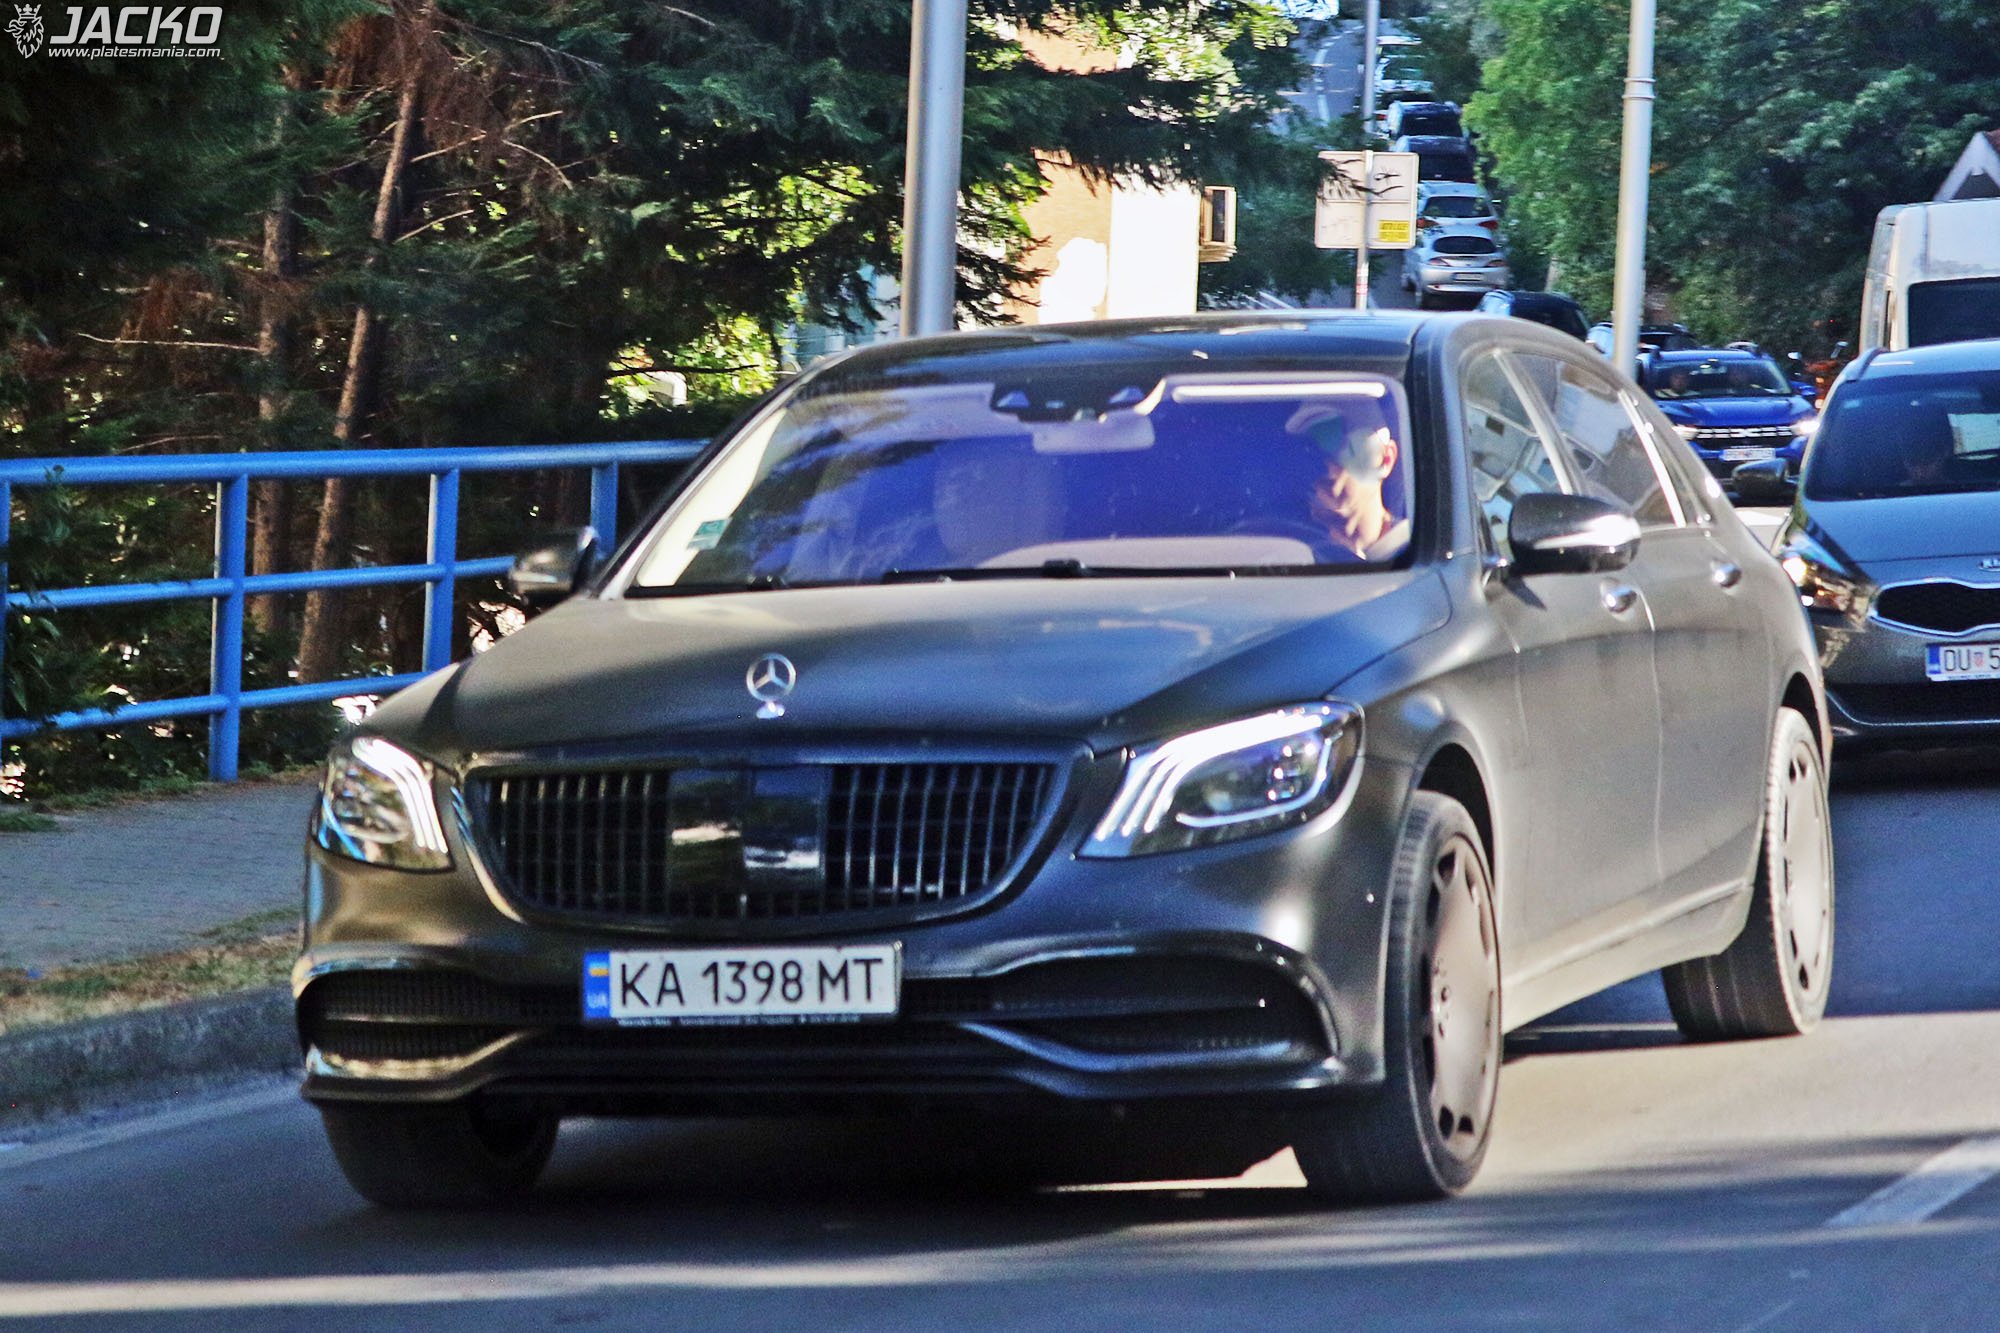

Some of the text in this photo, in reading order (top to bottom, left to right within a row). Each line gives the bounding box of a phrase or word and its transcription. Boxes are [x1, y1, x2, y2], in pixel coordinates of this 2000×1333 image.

[1944, 649, 1971, 671] DU
[620, 958, 883, 1007] KA 1398 MT
